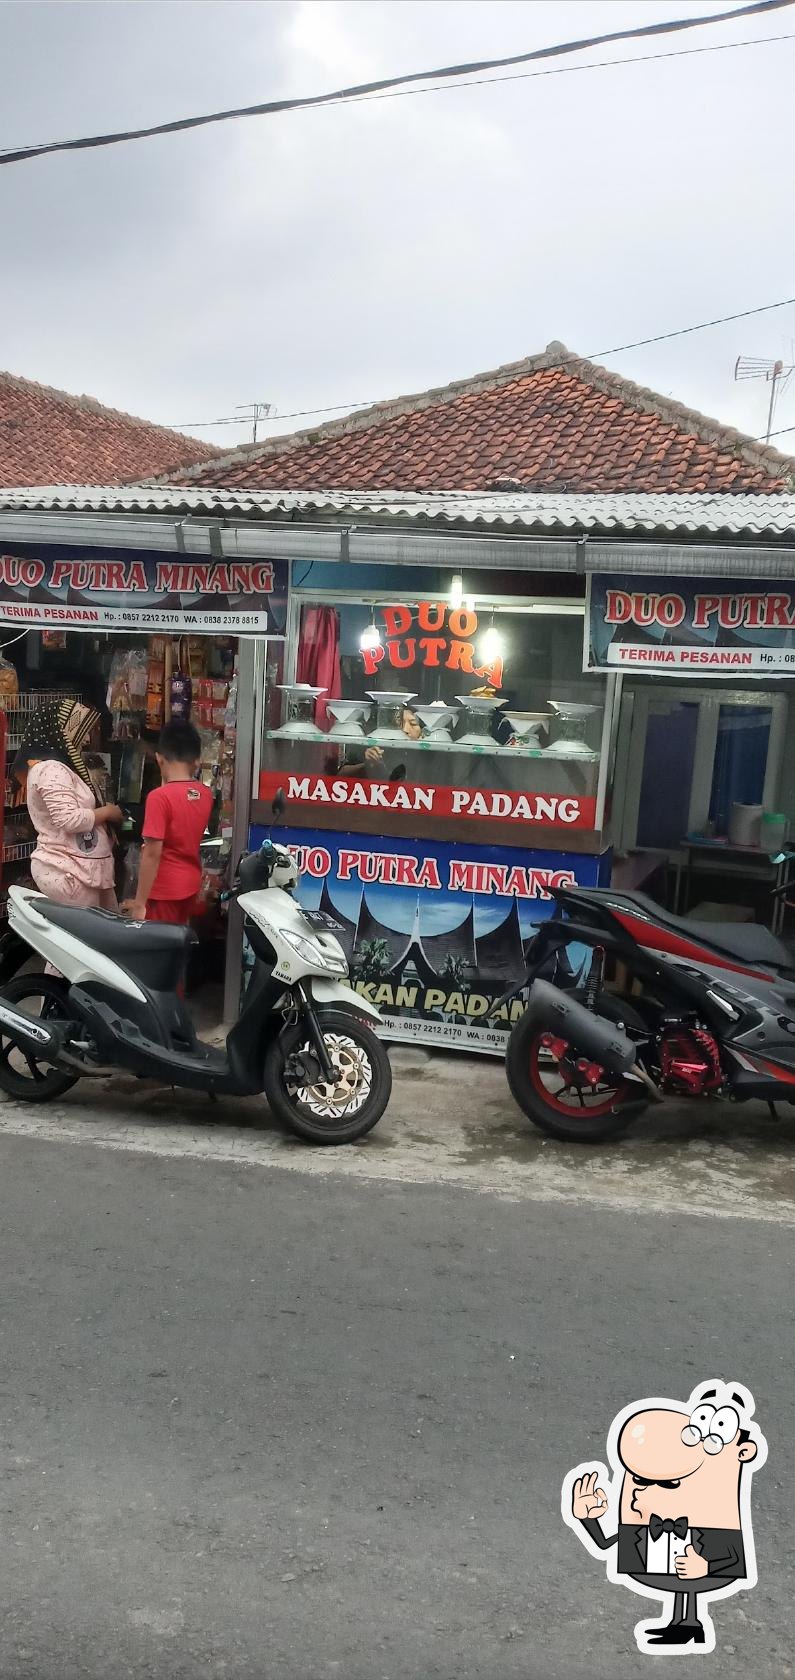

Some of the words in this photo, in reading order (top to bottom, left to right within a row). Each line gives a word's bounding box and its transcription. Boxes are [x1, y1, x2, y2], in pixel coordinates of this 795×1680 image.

[0, 555, 45, 587] UO
[48, 560, 148, 592] PUTRA
[153, 561, 274, 594] MINANG
[0, 606, 41, 618] TERIMA
[44, 608, 98, 620] PESANAN
[122, 613, 139, 621] 0857
[142, 614, 159, 622] 2212
[161, 614, 179, 623] 2170
[184, 615, 197, 623] WA
[223, 616, 240, 624] 2378
[383, 601, 478, 637] DUO
[604, 590, 686, 628] DUO
[692, 592, 795, 629] PUTR
[359, 637, 503, 688] PUTRA
[619, 648, 675, 662] TERIMA
[680, 651, 752, 664] PESANAN
[287, 776, 435, 811] MASAKAN
[451, 790, 581, 823] PADANG
[287, 845, 331, 878] UO
[337, 849, 442, 889] PUTRA
[448, 860, 578, 900] MINANG
[423, 988, 528, 1022] PADAN
[403, 1022, 421, 1031] 0857
[423, 1023, 442, 1033] 2212
[443, 1026, 462, 1036] 2170
[466, 1031, 480, 1040] WA
[486, 1034, 505, 1043] 0838
